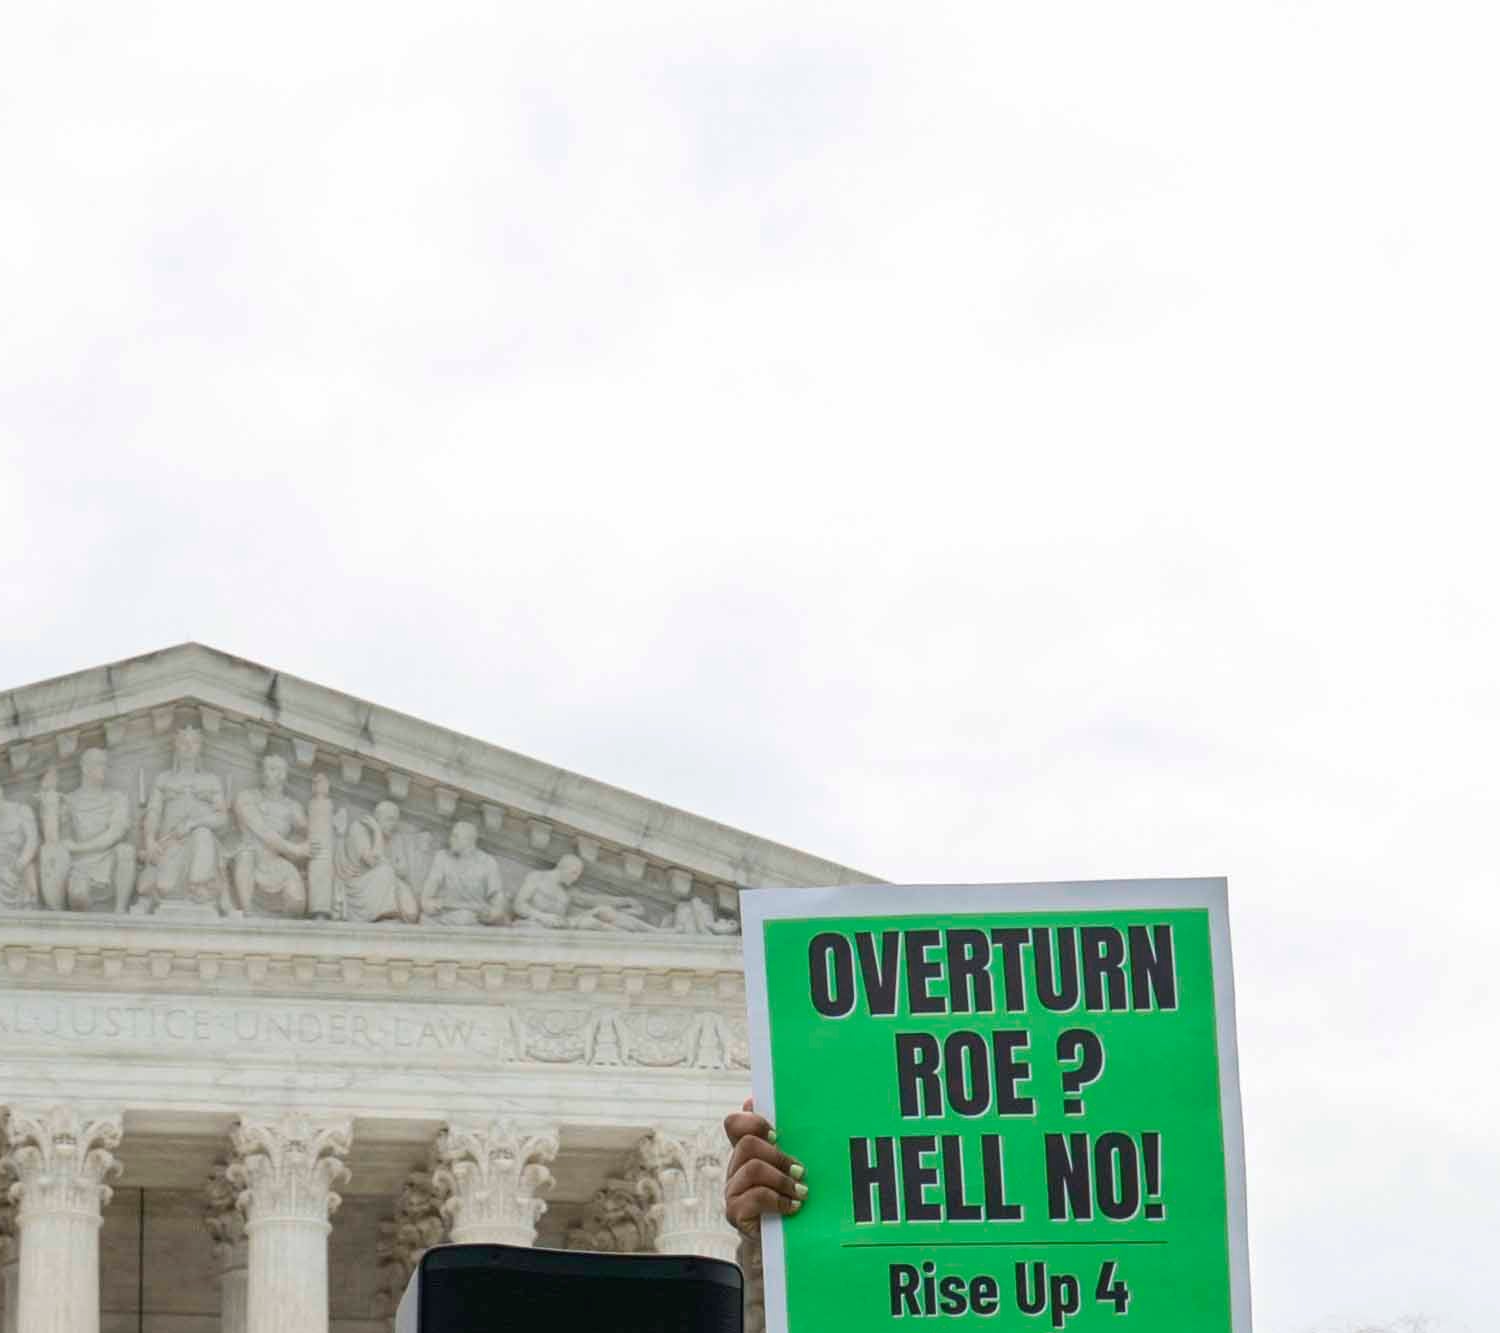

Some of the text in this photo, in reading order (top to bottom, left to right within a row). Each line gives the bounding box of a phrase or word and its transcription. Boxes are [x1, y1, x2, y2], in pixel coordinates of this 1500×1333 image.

[808, 924, 1180, 1019] OVERTURN
[39, 1004, 211, 1041] JUSTICE
[233, 1009, 382, 1047] UNDER
[393, 1015, 476, 1048] LAW
[895, 1028, 1106, 1119] ROE ?
[848, 1131, 1167, 1225] HELL NO!
[889, 1261, 1130, 1329] Rise Up 4
